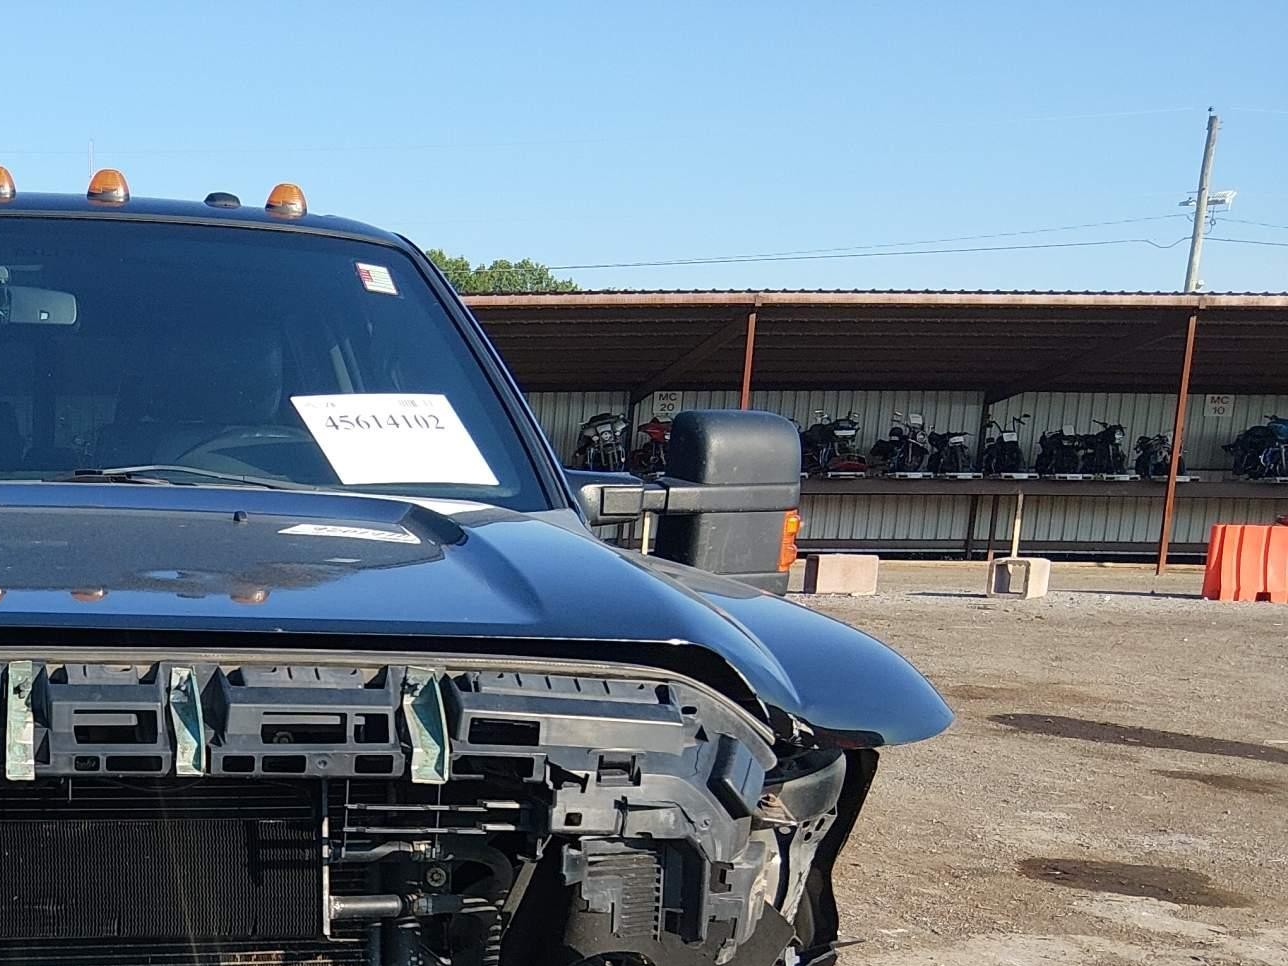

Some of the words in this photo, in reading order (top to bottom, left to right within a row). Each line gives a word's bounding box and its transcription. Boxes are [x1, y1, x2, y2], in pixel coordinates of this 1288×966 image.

[658, 392, 677, 401] MC
[1210, 395, 1231, 404] MC
[660, 403, 675, 412] 20
[1212, 406, 1225, 415] 10
[324, 414, 446, 430] 45614102
